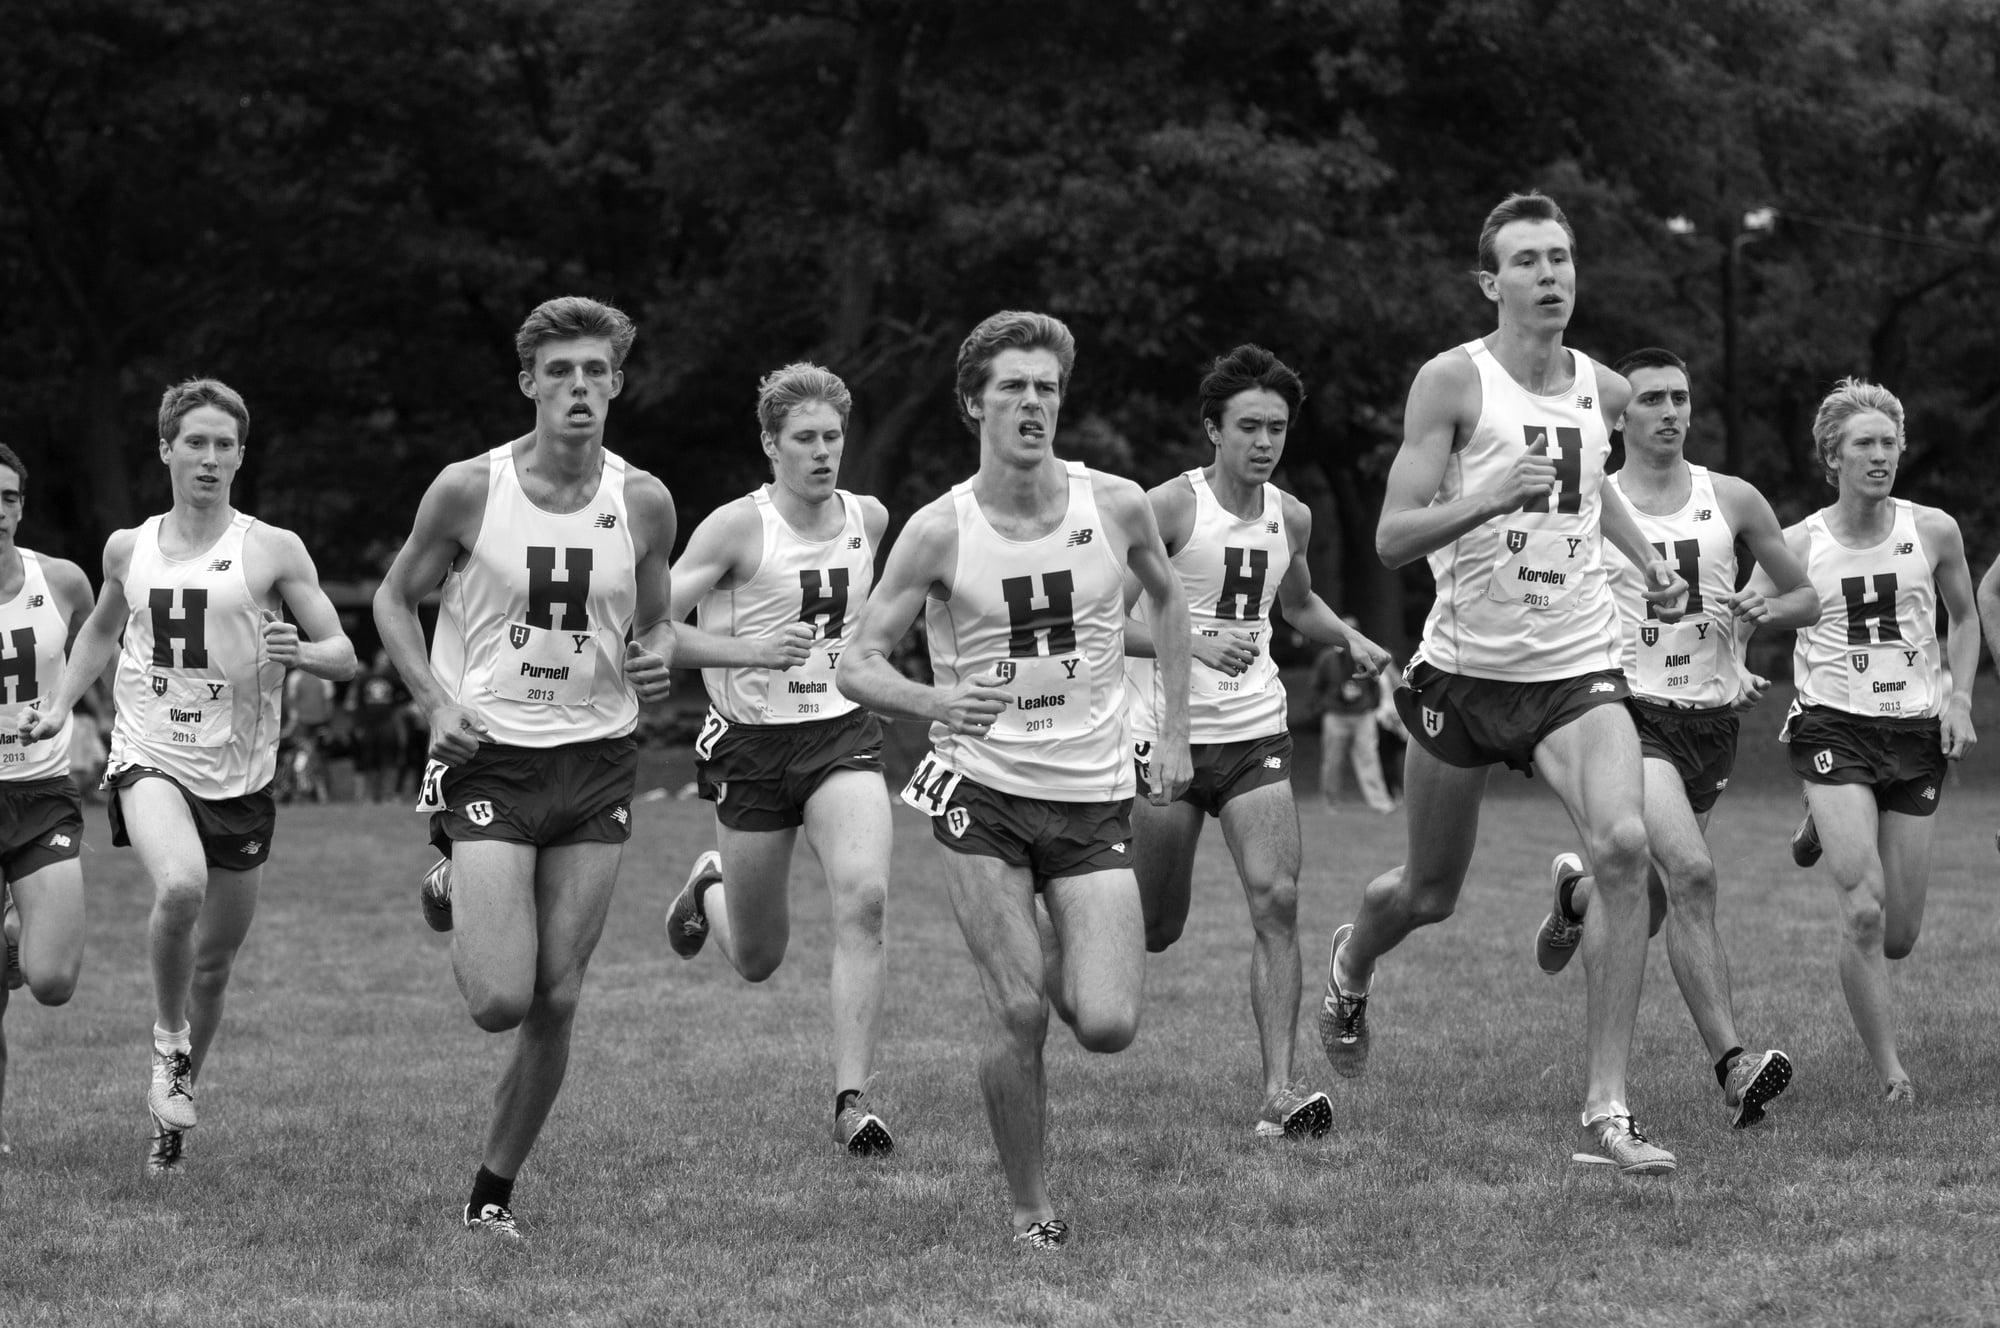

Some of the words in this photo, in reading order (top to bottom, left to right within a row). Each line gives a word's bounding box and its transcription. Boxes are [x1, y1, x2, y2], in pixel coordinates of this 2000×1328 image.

[1523, 425, 1583, 514] H
[1567, 538, 1582, 558] Y
[1215, 546, 1268, 620] H
[1518, 566, 1566, 585] Korolev
[1646, 539, 1703, 620] H
[526, 546, 593, 631] H
[800, 567, 849, 639] H
[1524, 593, 1549, 606] 2013
[1002, 570, 1076, 657] H
[1841, 573, 1902, 645] H
[149, 589, 208, 669] H
[1696, 623, 1710, 639] Y
[572, 634, 590, 653] Y
[0, 627, 38, 705] H
[828, 653, 840, 669] Y
[1665, 654, 1690, 668] Allen
[1904, 651, 1918, 667] Y
[520, 662, 569, 680] Purnell
[1061, 659, 1080, 679] Y
[788, 681, 827, 694] Meehan
[1218, 681, 1239, 691] 2013
[1667, 675, 1689, 687] 2013
[1873, 679, 1906, 694] Gemar
[208, 684, 224, 699] Y
[527, 689, 554, 701] 2013
[798, 703, 819, 713] 2013
[1017, 695, 1065, 710] Leakos
[1880, 702, 1900, 711] 2013
[170, 709, 201, 723] Ward
[1026, 718, 1053, 732] 2013
[172, 732, 196, 744] 2013
[3, 753, 25, 763] 2013
